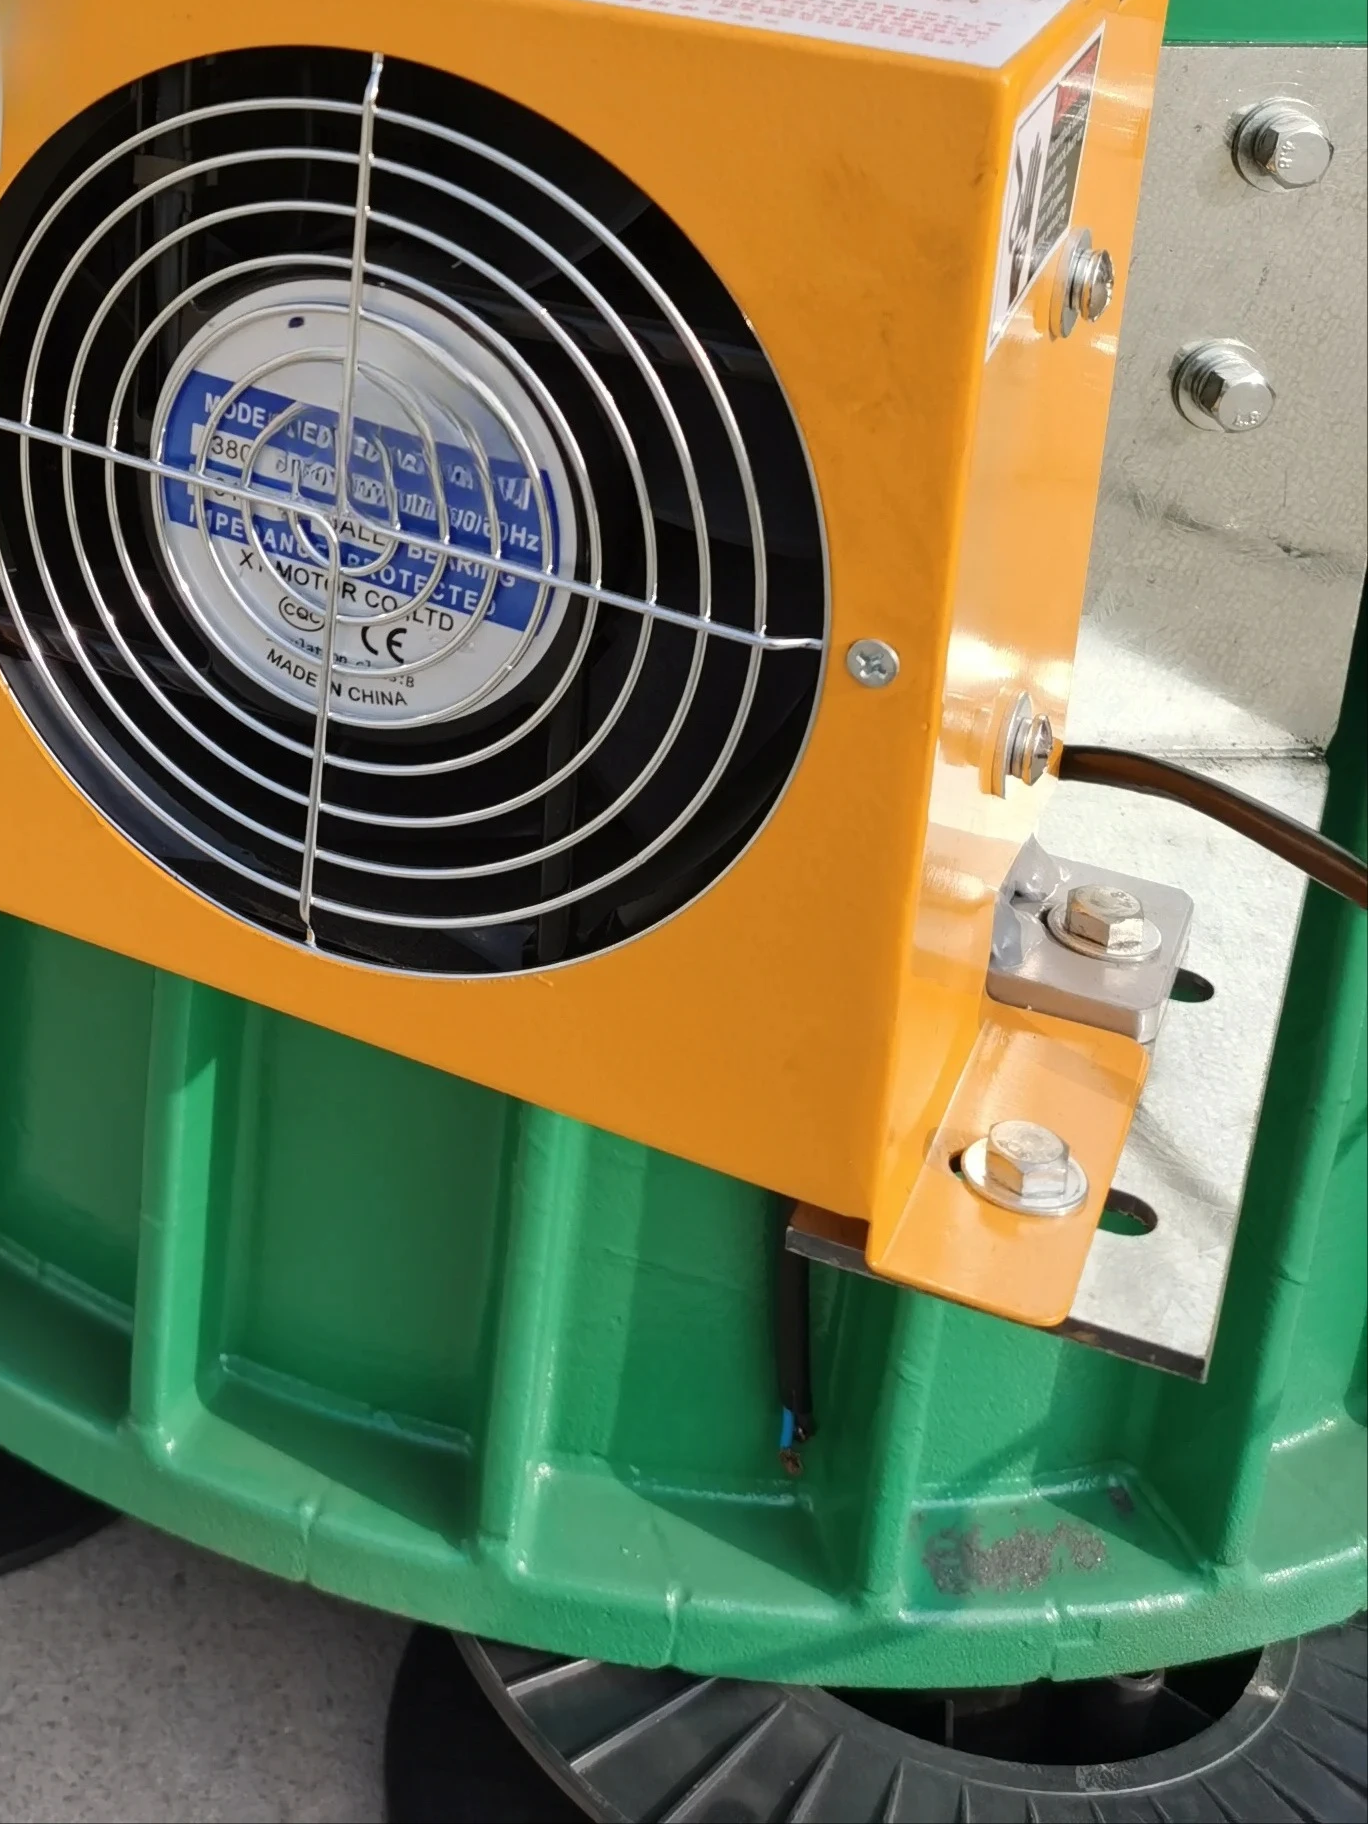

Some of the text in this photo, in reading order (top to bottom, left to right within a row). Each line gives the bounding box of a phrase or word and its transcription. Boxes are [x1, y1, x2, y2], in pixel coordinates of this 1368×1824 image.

[361, 626, 407, 664] CE
[267, 648, 319, 688] MADE
[348, 686, 408, 706] CHINA
